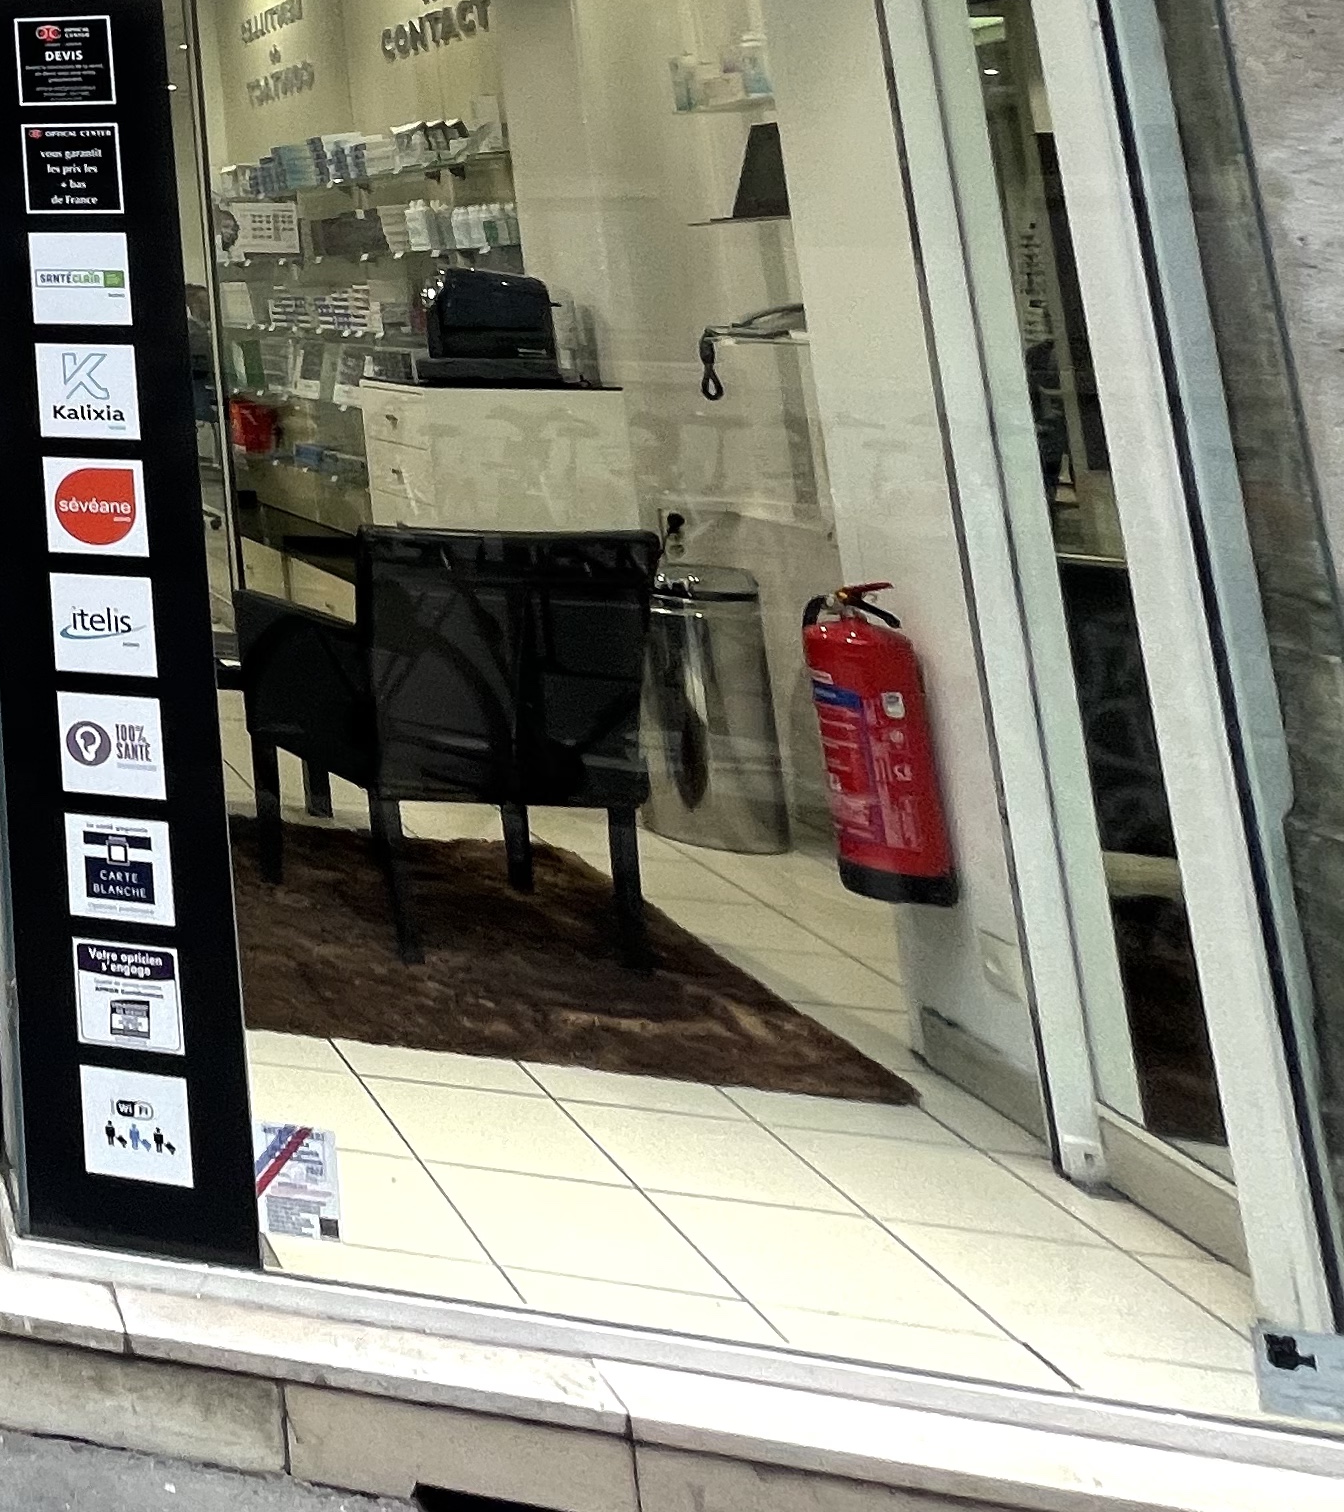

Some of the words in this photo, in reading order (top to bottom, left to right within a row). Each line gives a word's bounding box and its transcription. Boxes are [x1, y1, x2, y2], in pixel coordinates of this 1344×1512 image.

[44, 50, 84, 62] DEVIS
[64, 194, 99, 205] France
[52, 404, 126, 422] Kalixia
[58, 496, 131, 515] sévéane
[71, 605, 133, 634] itelis
[115, 723, 147, 743] 100%
[99, 869, 139, 884] CARTE
[92, 882, 147, 899] BLANCHE
[88, 946, 118, 963] Votre
[120, 952, 164, 967] opticien
